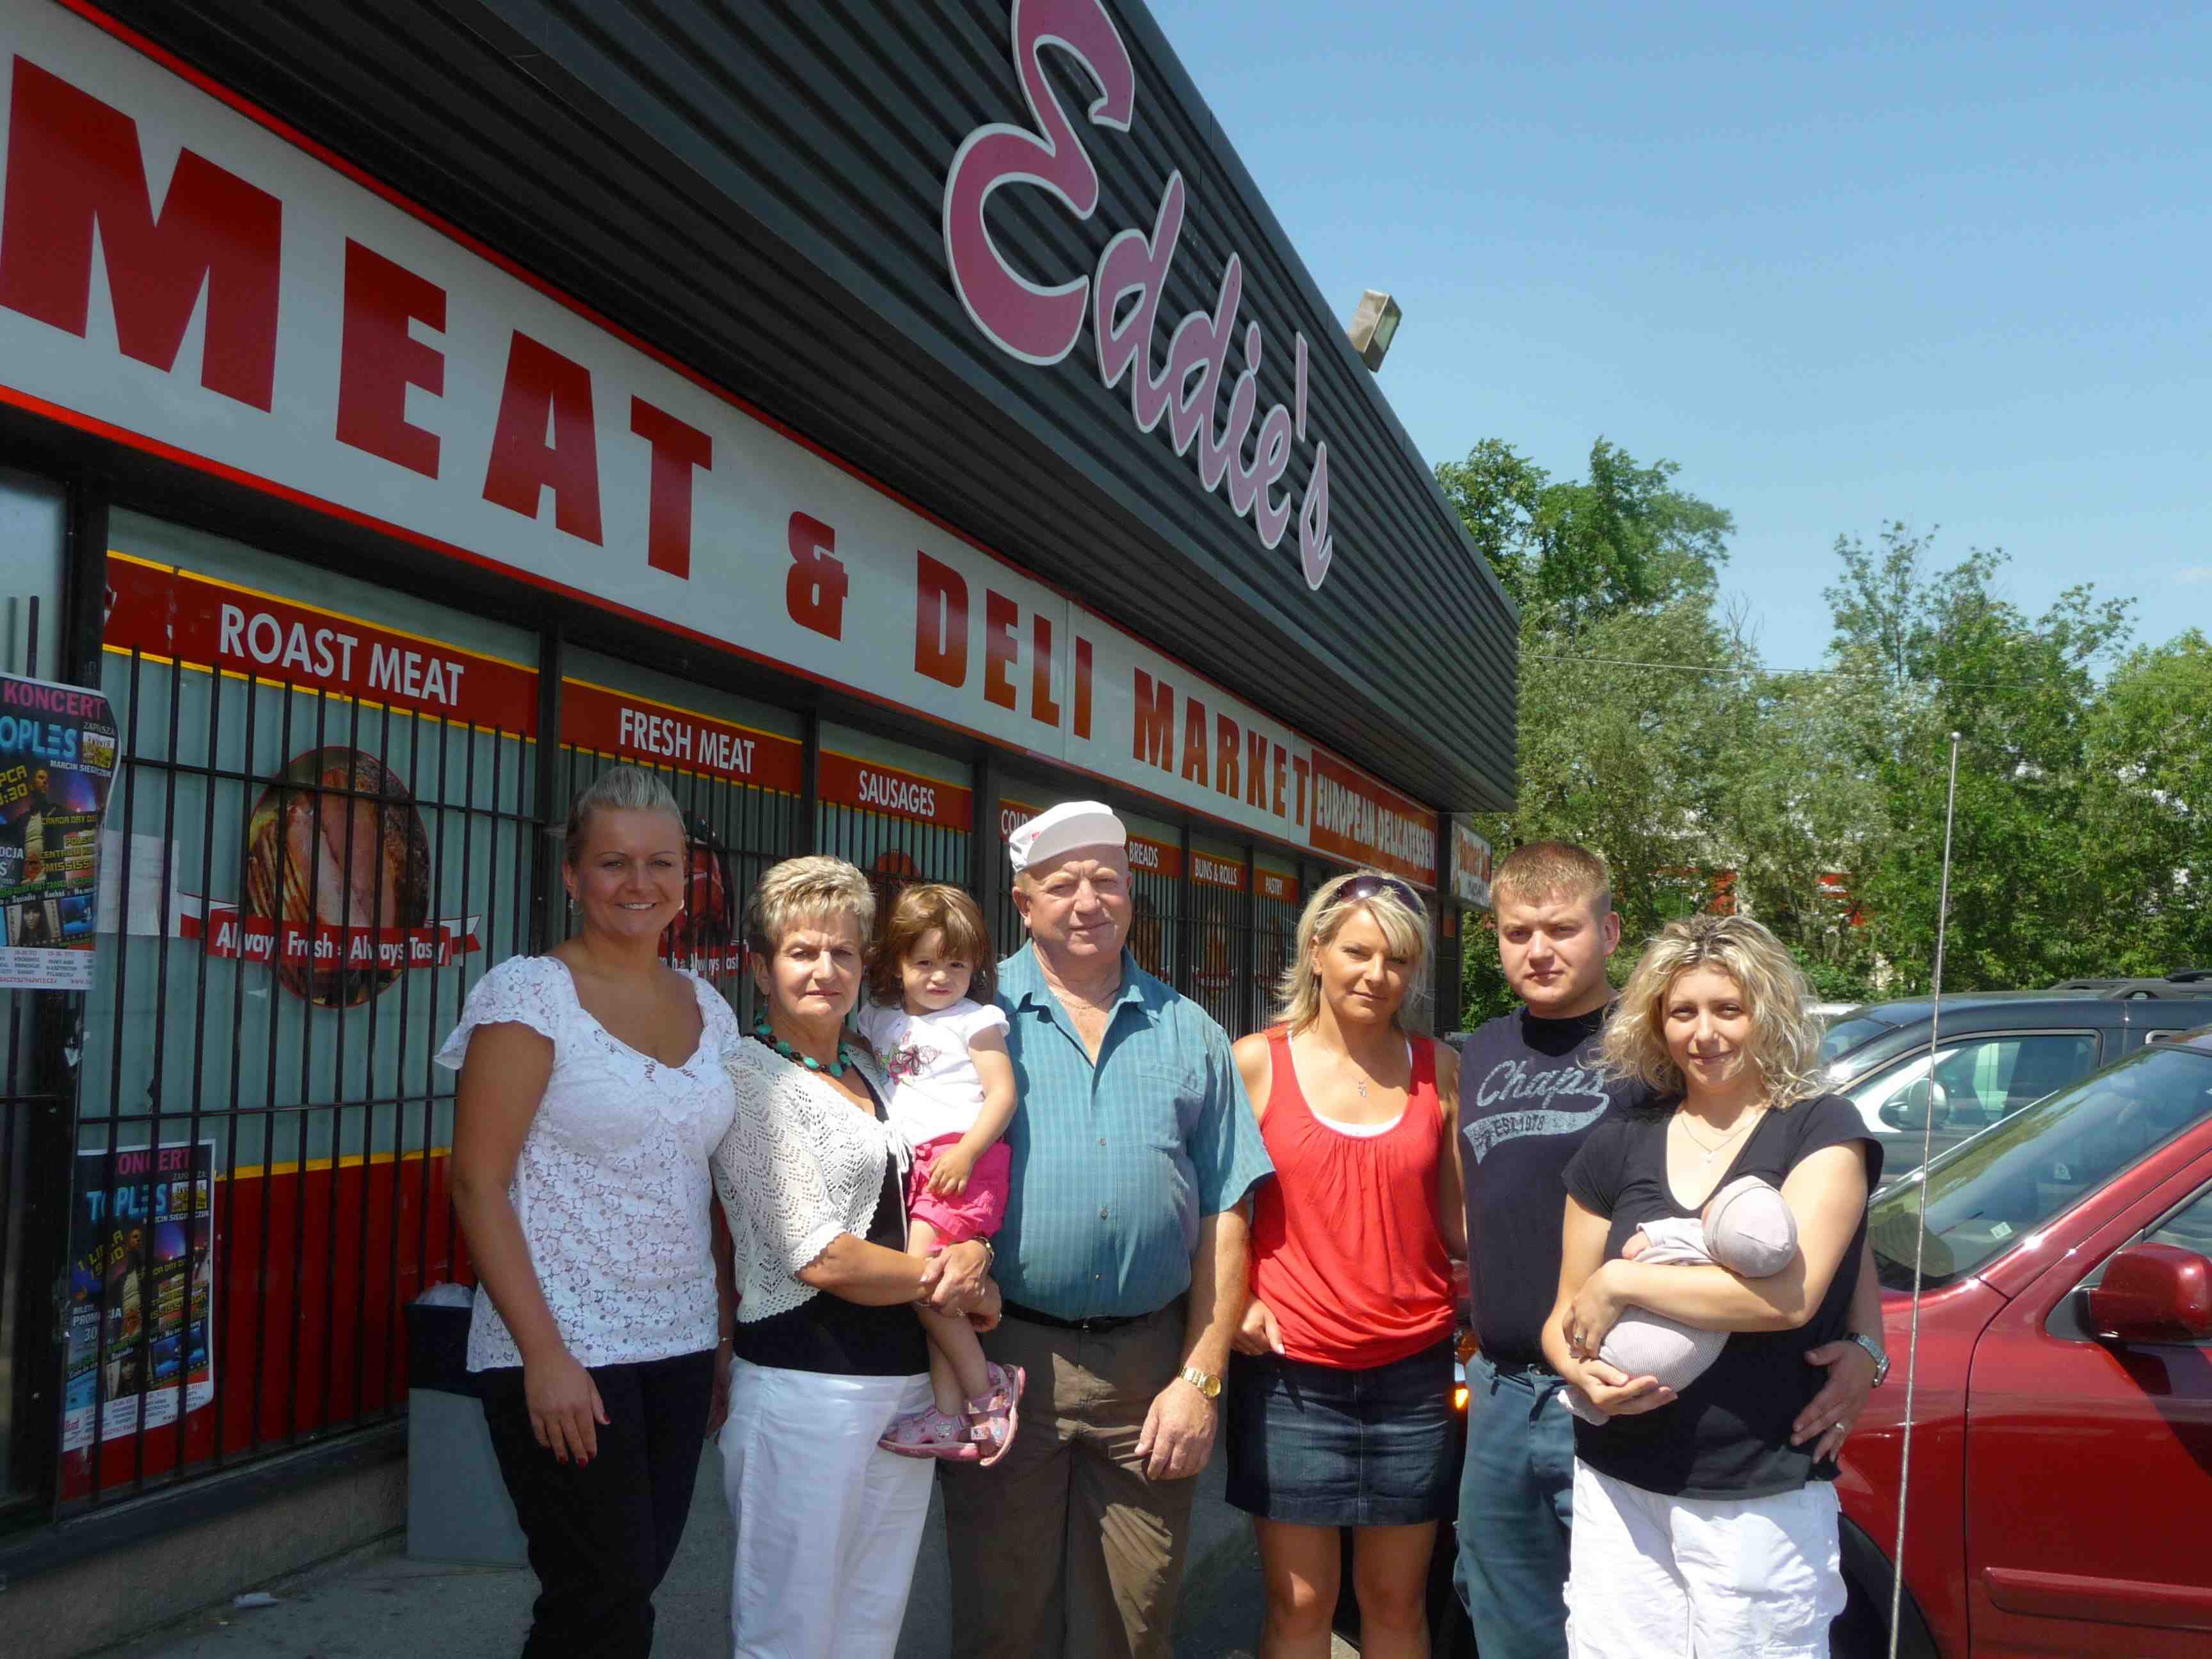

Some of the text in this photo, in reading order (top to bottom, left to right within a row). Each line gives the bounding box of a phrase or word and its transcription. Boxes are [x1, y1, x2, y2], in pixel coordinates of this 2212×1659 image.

[943, 0, 1333, 591] Eddie's
[0, 53, 1310, 826] MEAT & DELI MARKET
[220, 603, 465, 706] ROAST MEAT
[3, 680, 105, 719] KONCERT
[619, 707, 755, 774] FRESH MEAT
[859, 770, 935, 817] SAUSAGES
[1316, 773, 1375, 847] EUROPEAN
[1128, 841, 1158, 868] BREADS
[1194, 858, 1237, 886] BUNS & ROLLS
[1265, 875, 1284, 895] PASTRY
[287, 931, 333, 958] Frsh
[409, 936, 445, 965] Tasy
[1476, 1060, 1606, 1109] Chaps
[72, 1307, 123, 1327] PROMJA
